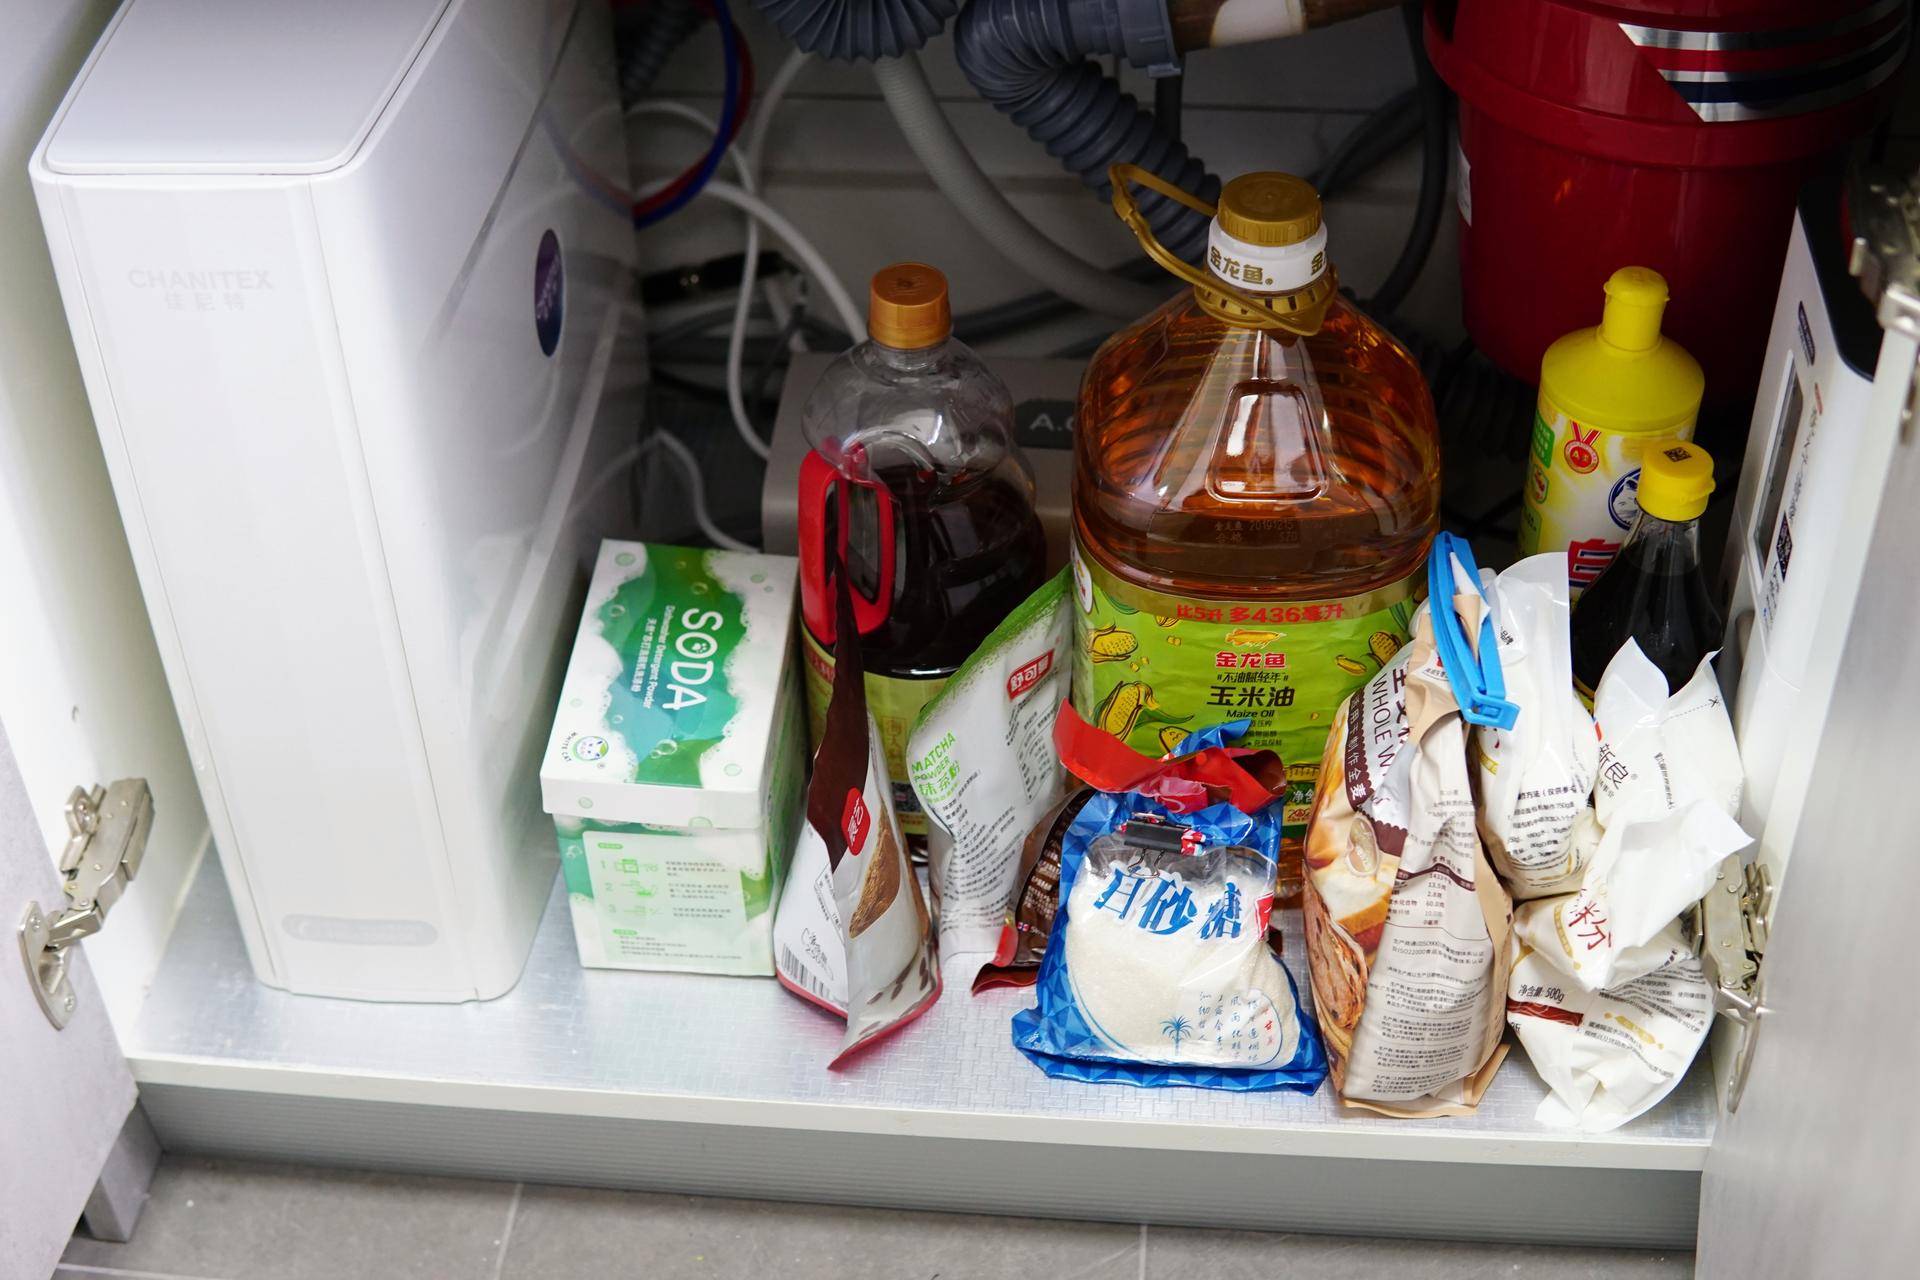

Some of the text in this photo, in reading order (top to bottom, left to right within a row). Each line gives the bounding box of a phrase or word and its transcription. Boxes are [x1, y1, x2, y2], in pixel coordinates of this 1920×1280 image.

[128, 269, 273, 290] CHANITEX
[1210, 246, 1263, 285] 金龙鱼
[1177, 603, 1345, 625] 比5升 多436毫升
[663, 608, 724, 711] SODA
[1215, 650, 1286, 669] 金龙鱼
[643, 681, 658, 709] Powder
[1206, 686, 1295, 707] 玉米油
[1372, 673, 1393, 745] WHOLE
[1226, 710, 1275, 718] Maize Oil
[912, 730, 956, 773] MATCHA
[914, 755, 950, 783] POWDER
[1093, 865, 1241, 939] 白砂糖
[1545, 987, 1565, 1004] 500g
